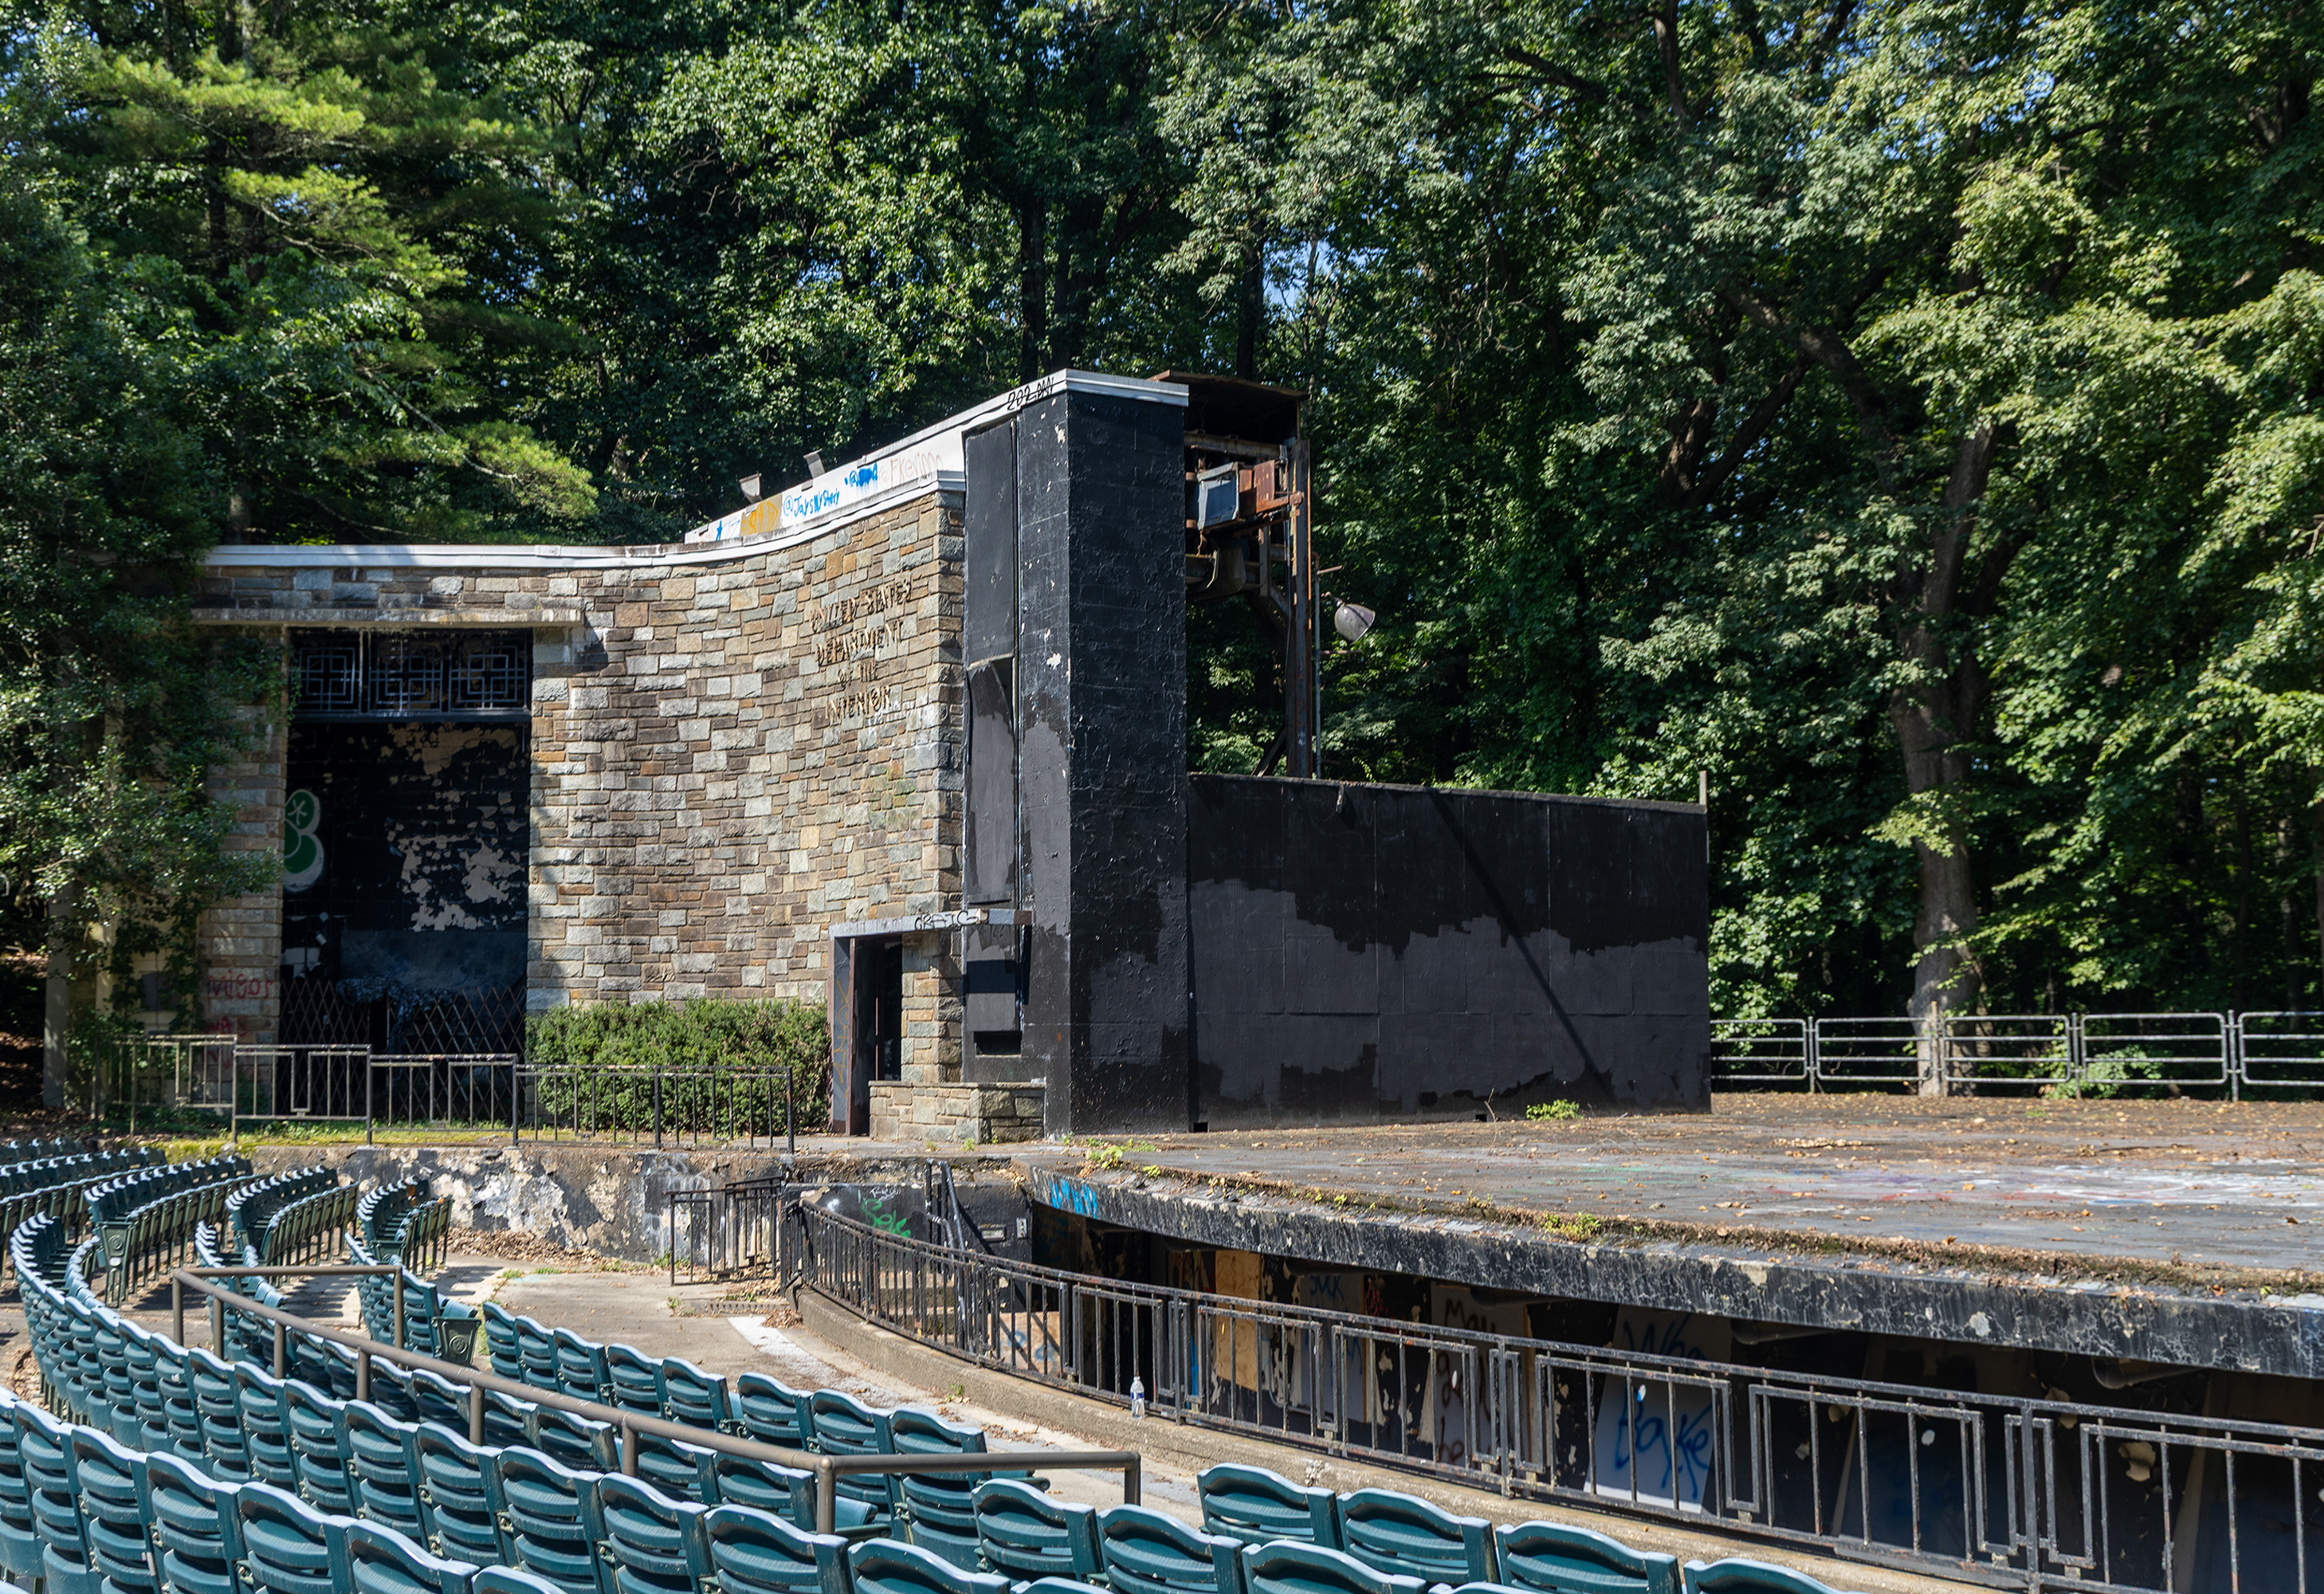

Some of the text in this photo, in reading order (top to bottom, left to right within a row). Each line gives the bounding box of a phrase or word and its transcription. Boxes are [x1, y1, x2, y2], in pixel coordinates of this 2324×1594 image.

[810, 579, 912, 633] UNITED STATES
[815, 619, 903, 666] DEPARTMENT
[838, 661, 877, 687] OF THE
[826, 685, 892, 720] INTERIOR
